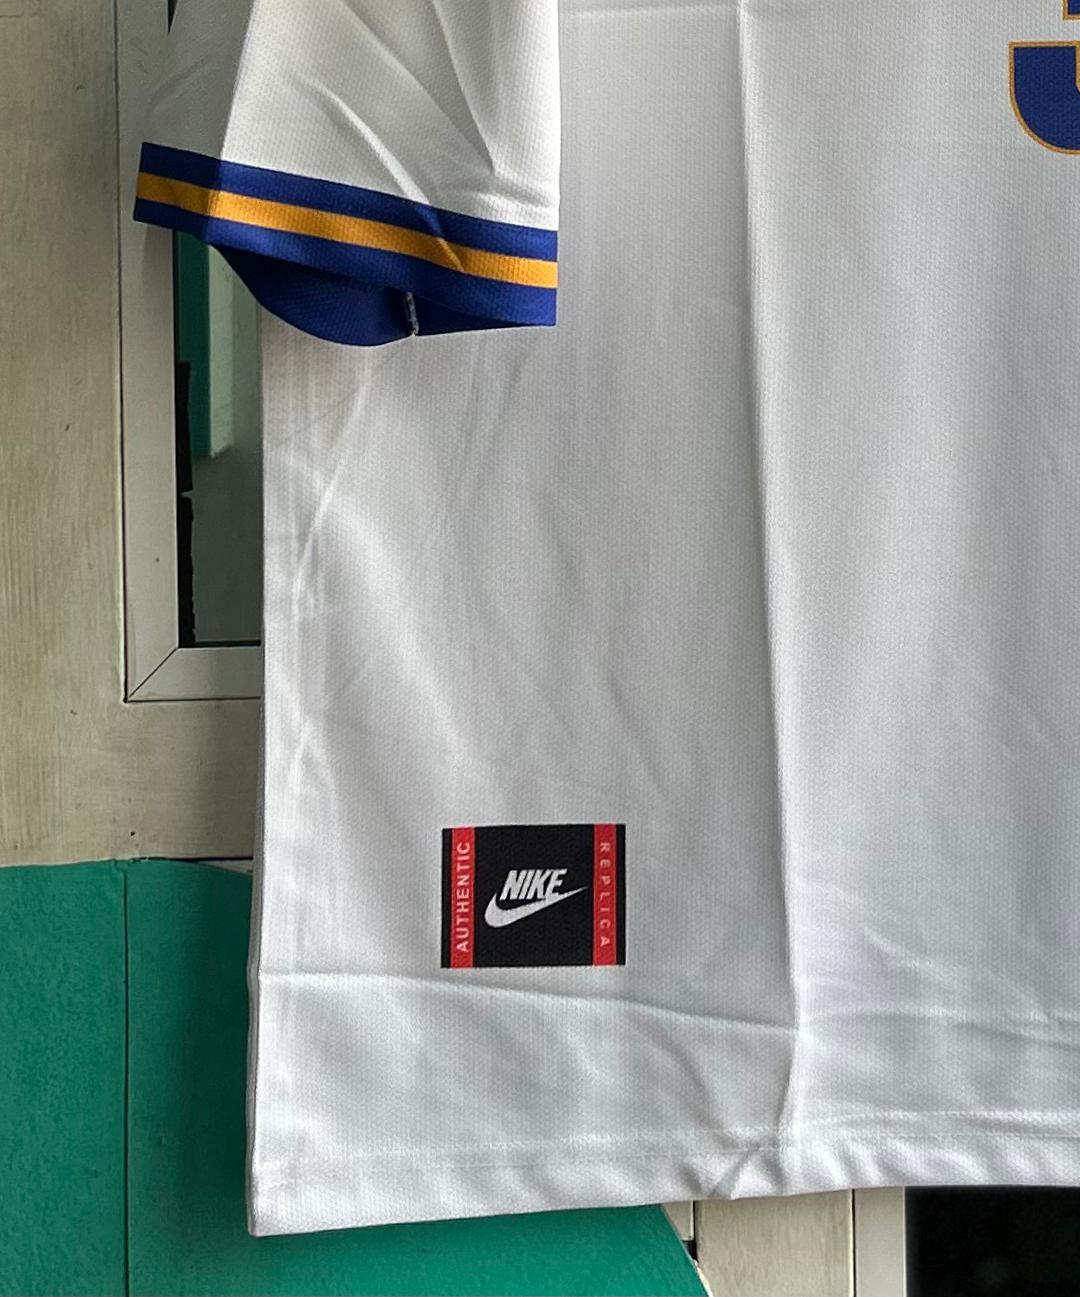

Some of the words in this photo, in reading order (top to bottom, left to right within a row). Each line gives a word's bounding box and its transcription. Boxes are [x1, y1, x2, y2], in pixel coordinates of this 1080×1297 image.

[456, 841, 471, 952] AUTHENTIC
[499, 868, 568, 900] NIKE
[600, 842, 611, 947] REPLICA
